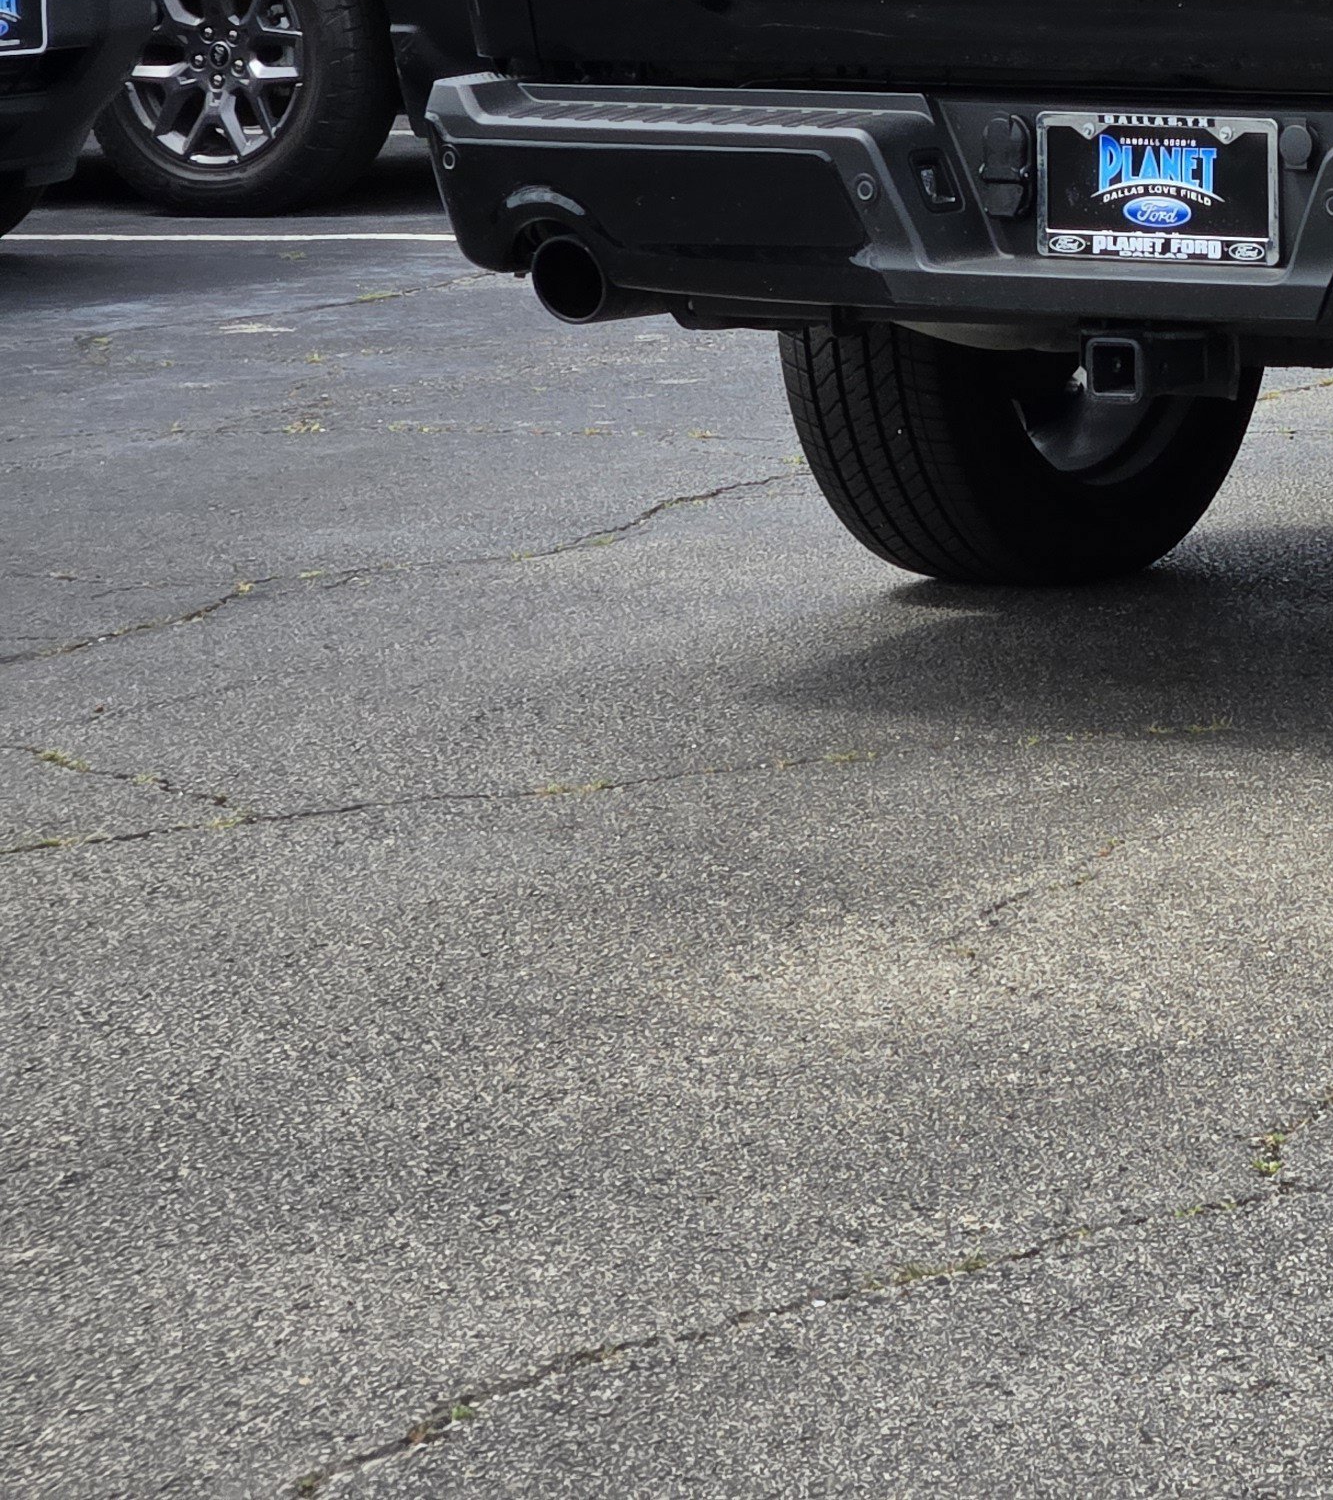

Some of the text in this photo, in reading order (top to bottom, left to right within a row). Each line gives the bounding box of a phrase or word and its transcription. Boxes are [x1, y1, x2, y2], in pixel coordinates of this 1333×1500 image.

[1099, 134, 1217, 194] PLANET
[1103, 185, 1212, 206] DALLAS LOVE FIELD
[1137, 199, 1179, 223] Ford
[1092, 235, 1165, 254] PLANET
[1170, 238, 1223, 260] FORD
